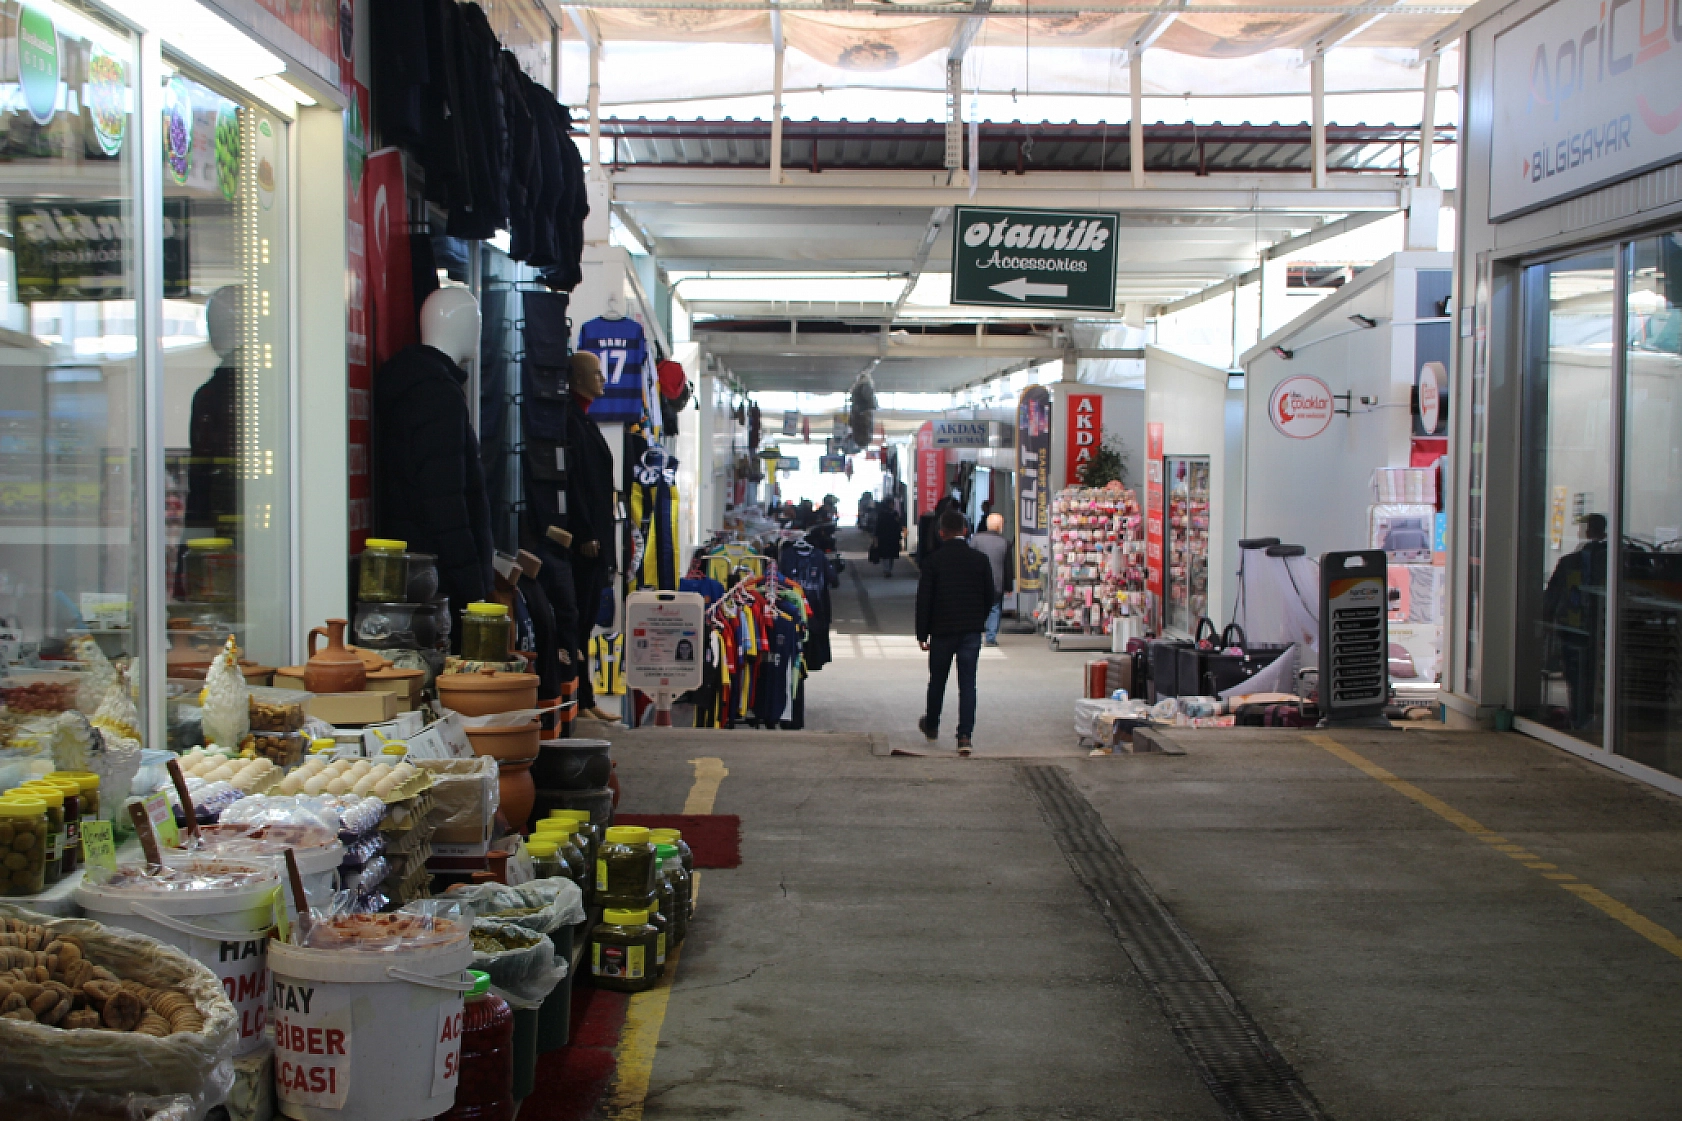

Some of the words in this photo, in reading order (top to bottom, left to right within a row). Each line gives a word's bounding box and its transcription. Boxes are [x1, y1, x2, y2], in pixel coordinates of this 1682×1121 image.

[1531, 113, 1632, 183] BİLGİSAYAR
[963, 217, 1110, 252] otantik
[975, 250, 1088, 272] Accessories
[599, 350, 627, 384] 17
[276, 1016, 346, 1055] BİBER
